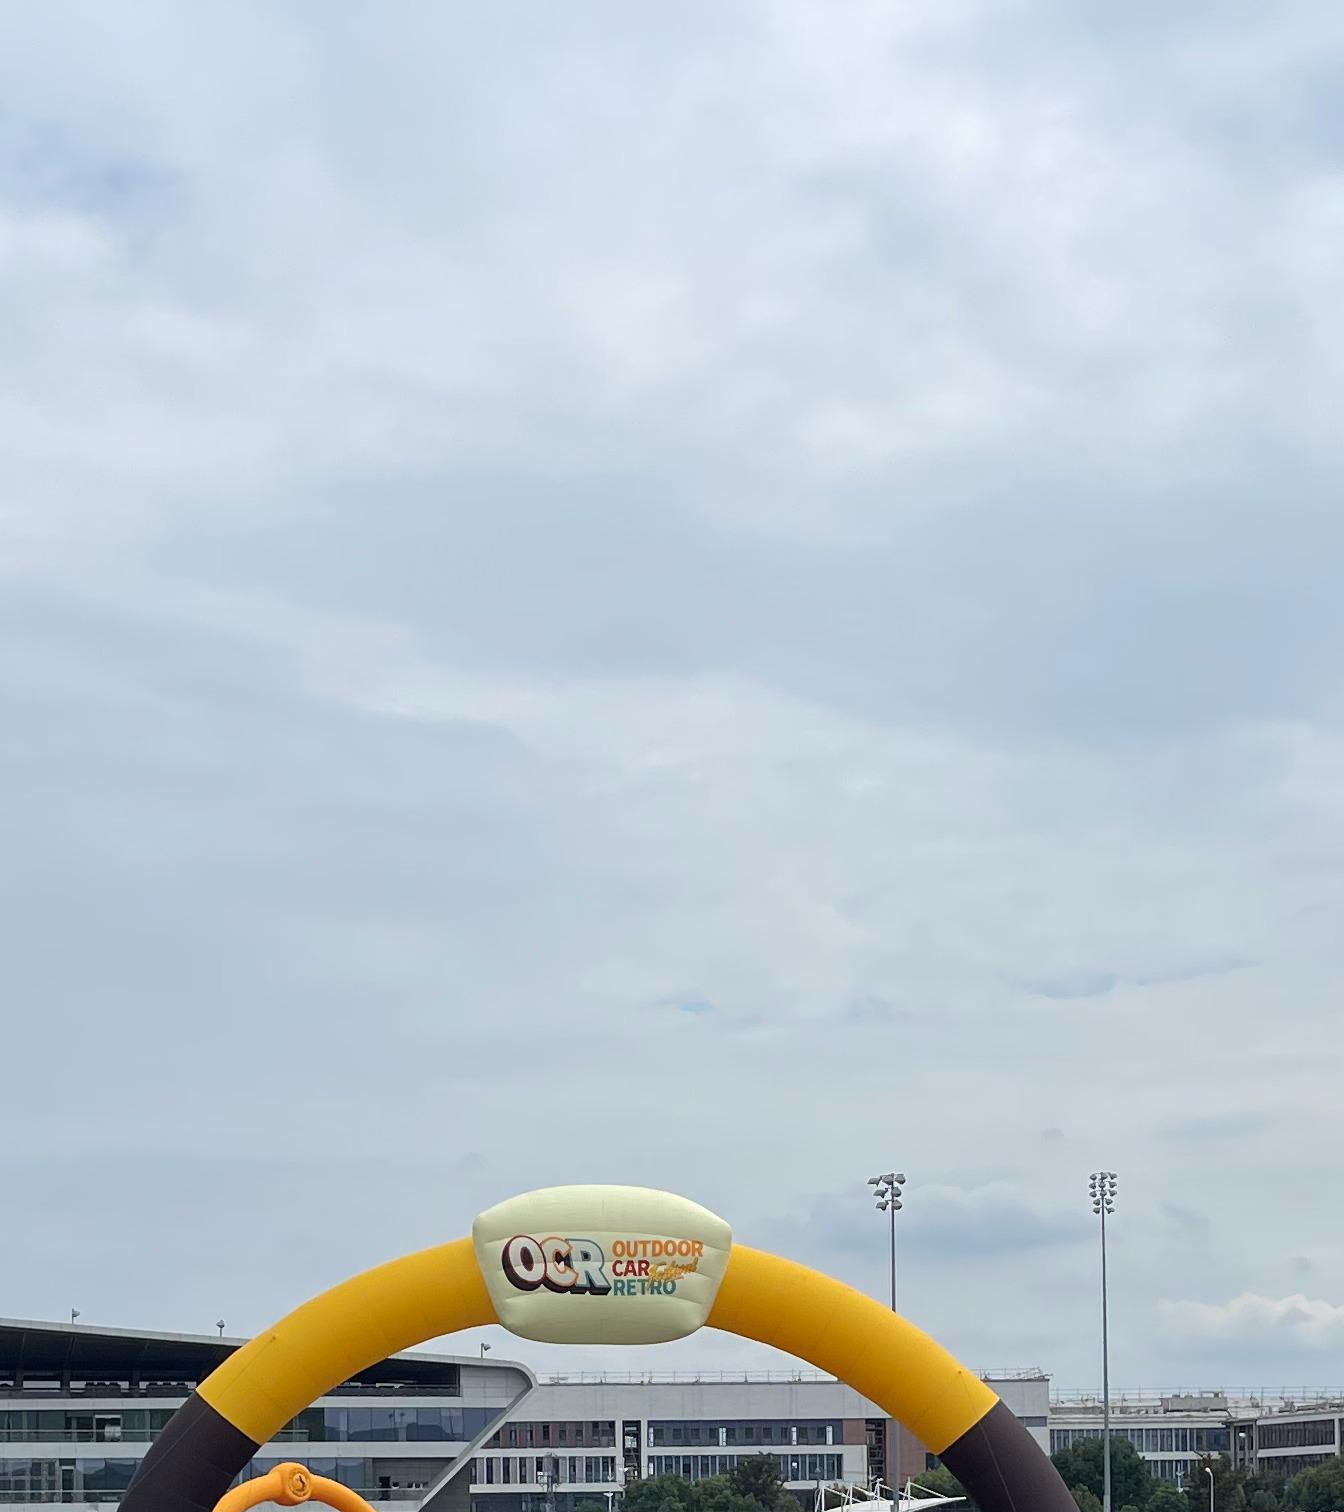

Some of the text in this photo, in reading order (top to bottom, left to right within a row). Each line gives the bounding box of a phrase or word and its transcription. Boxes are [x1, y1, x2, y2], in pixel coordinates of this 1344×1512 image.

[612, 1240, 704, 1258] OUTDOOR
[503, 1235, 611, 1295] OCR
[612, 1260, 649, 1278] CAR
[613, 1278, 677, 1297] RETRO
